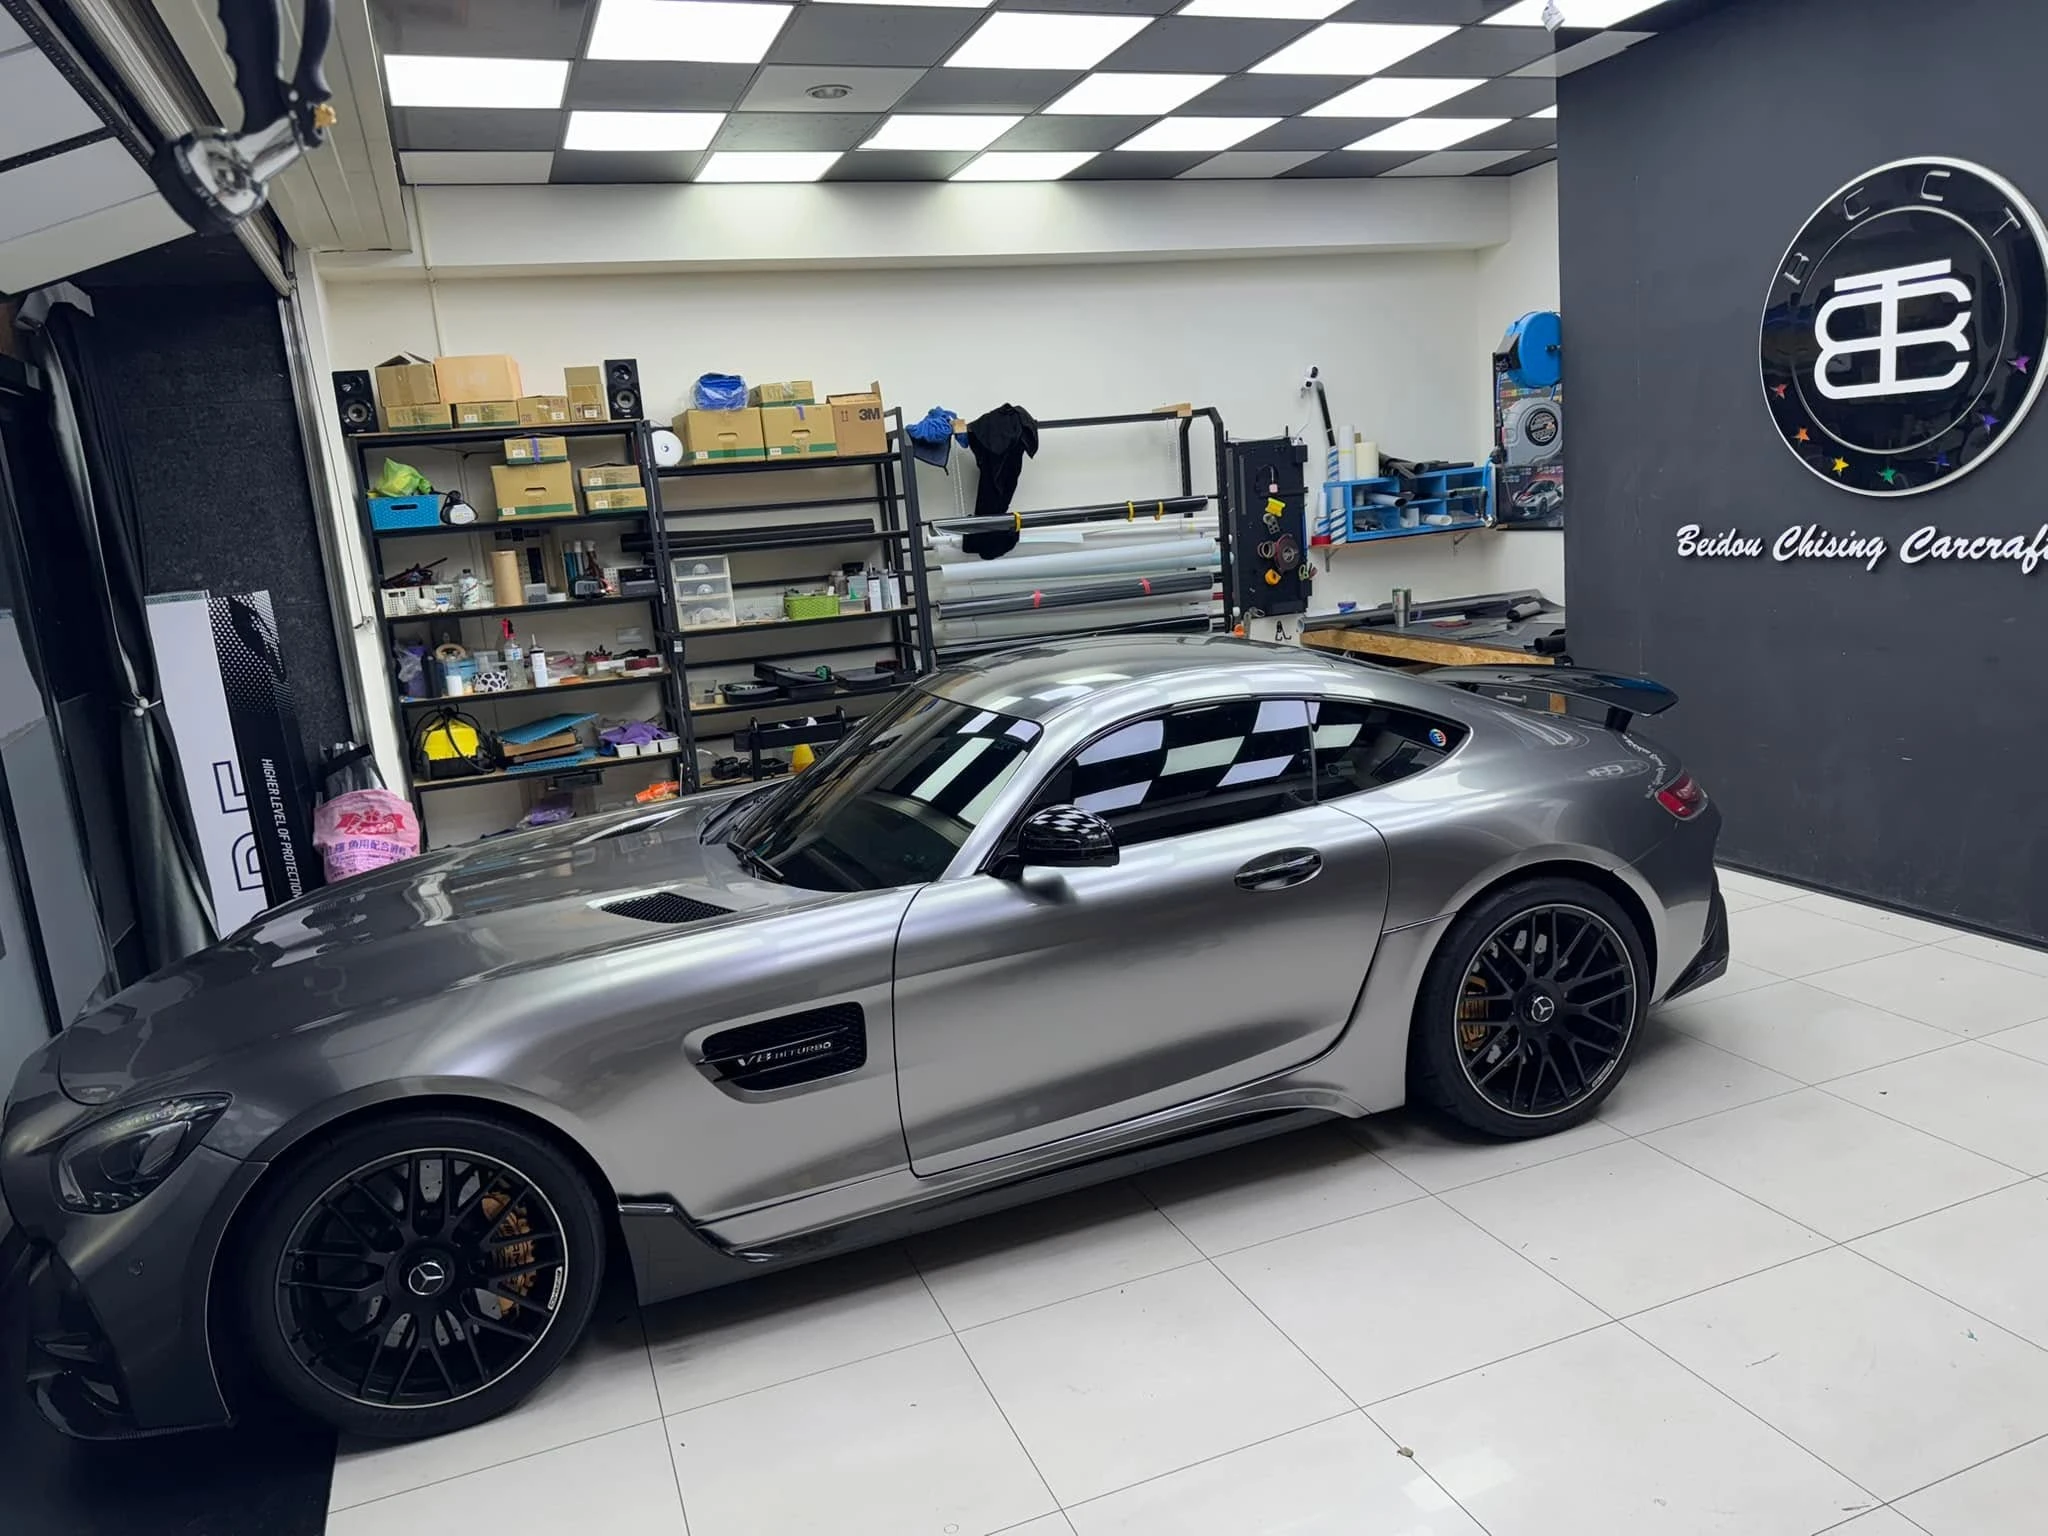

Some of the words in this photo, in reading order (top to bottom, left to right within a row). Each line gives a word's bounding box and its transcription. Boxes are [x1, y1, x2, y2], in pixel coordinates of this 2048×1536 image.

[858, 407, 881, 421] 3M
[1676, 524, 1763, 558] Beidou
[1772, 525, 1887, 571] Chising
[261, 758, 280, 795] HIGHER
[270, 796, 287, 827] LEVEL
[277, 828, 291, 842] OF
[280, 841, 303, 898] PROTECTION
